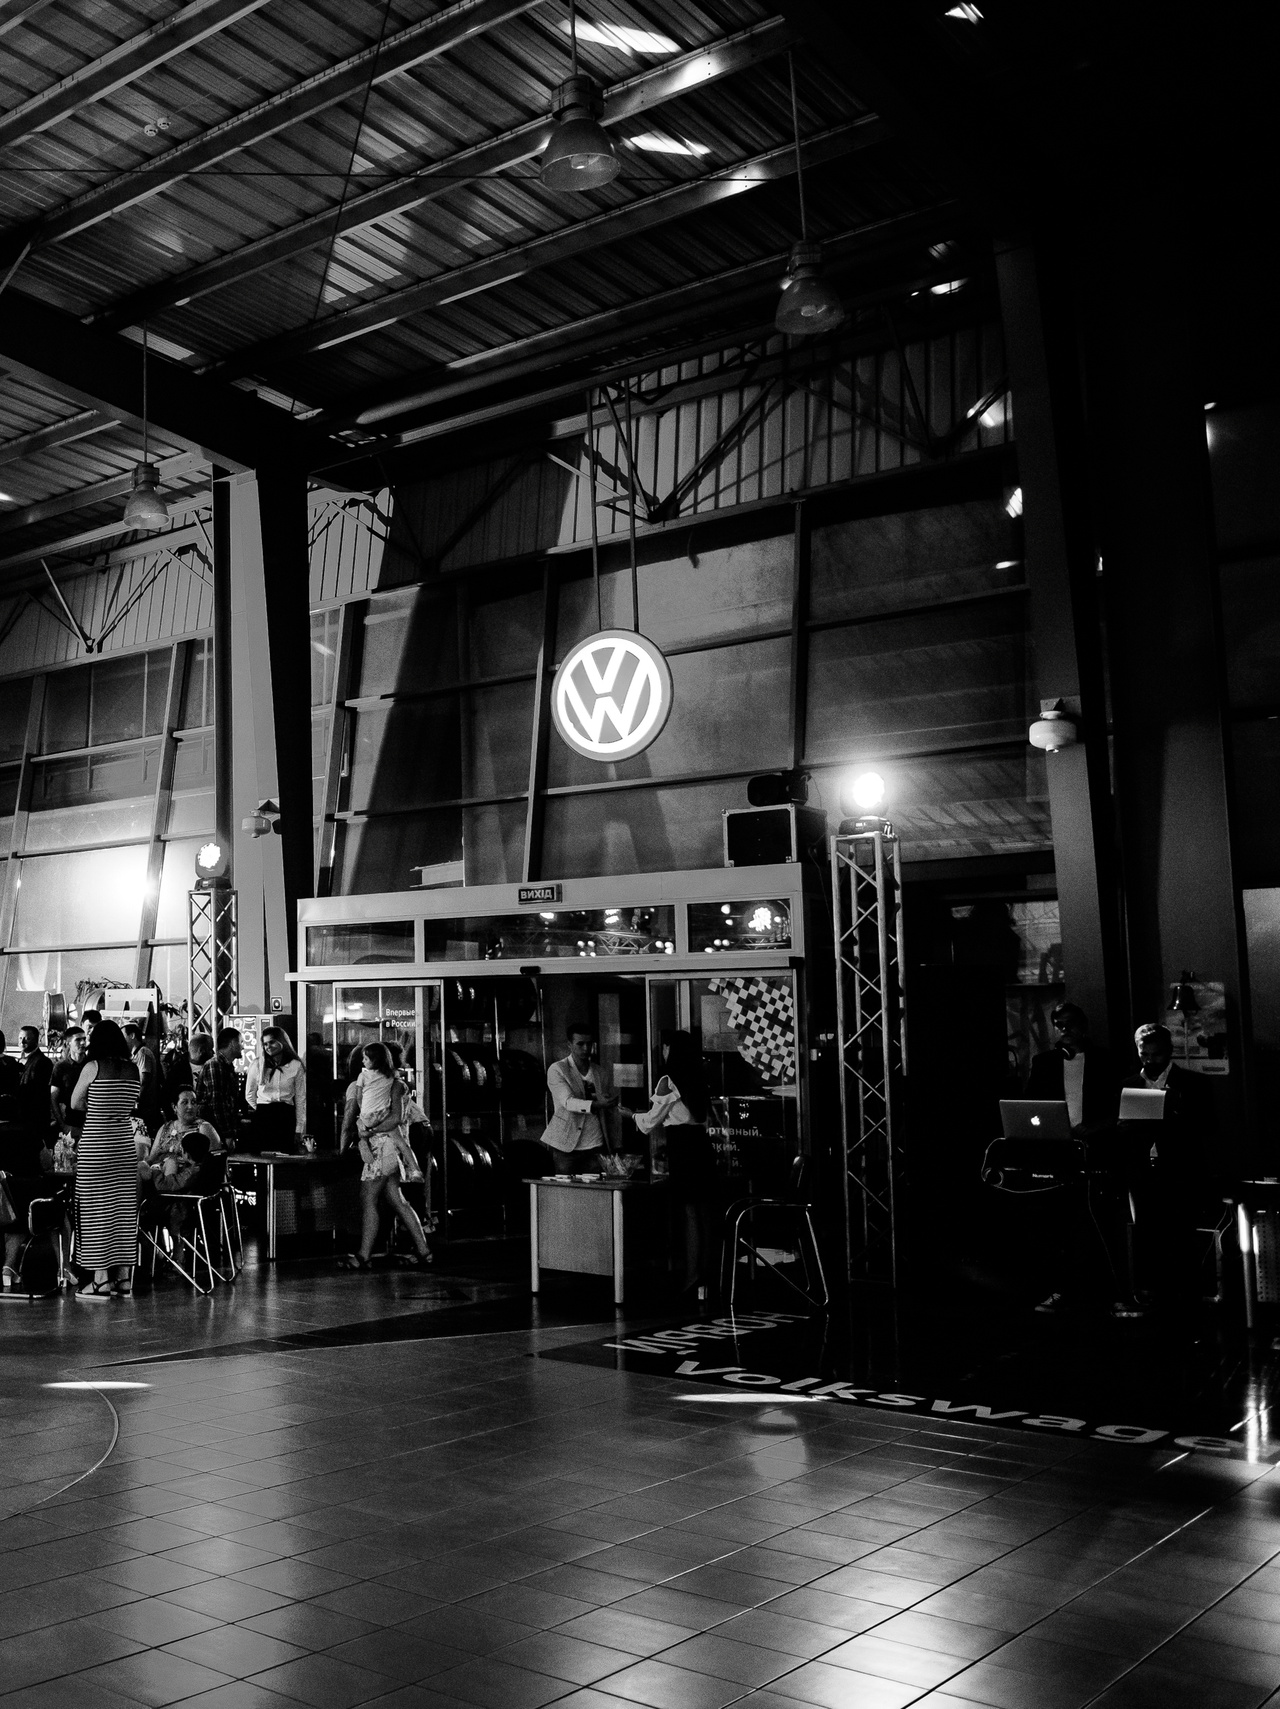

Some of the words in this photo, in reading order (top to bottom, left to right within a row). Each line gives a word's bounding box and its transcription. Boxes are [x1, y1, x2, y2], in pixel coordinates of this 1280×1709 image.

[557, 637, 662, 754] VW
[520, 889, 553, 900] ВИХІД
[385, 1008, 416, 1018] Впервые
[391, 1019, 416, 1028] России
